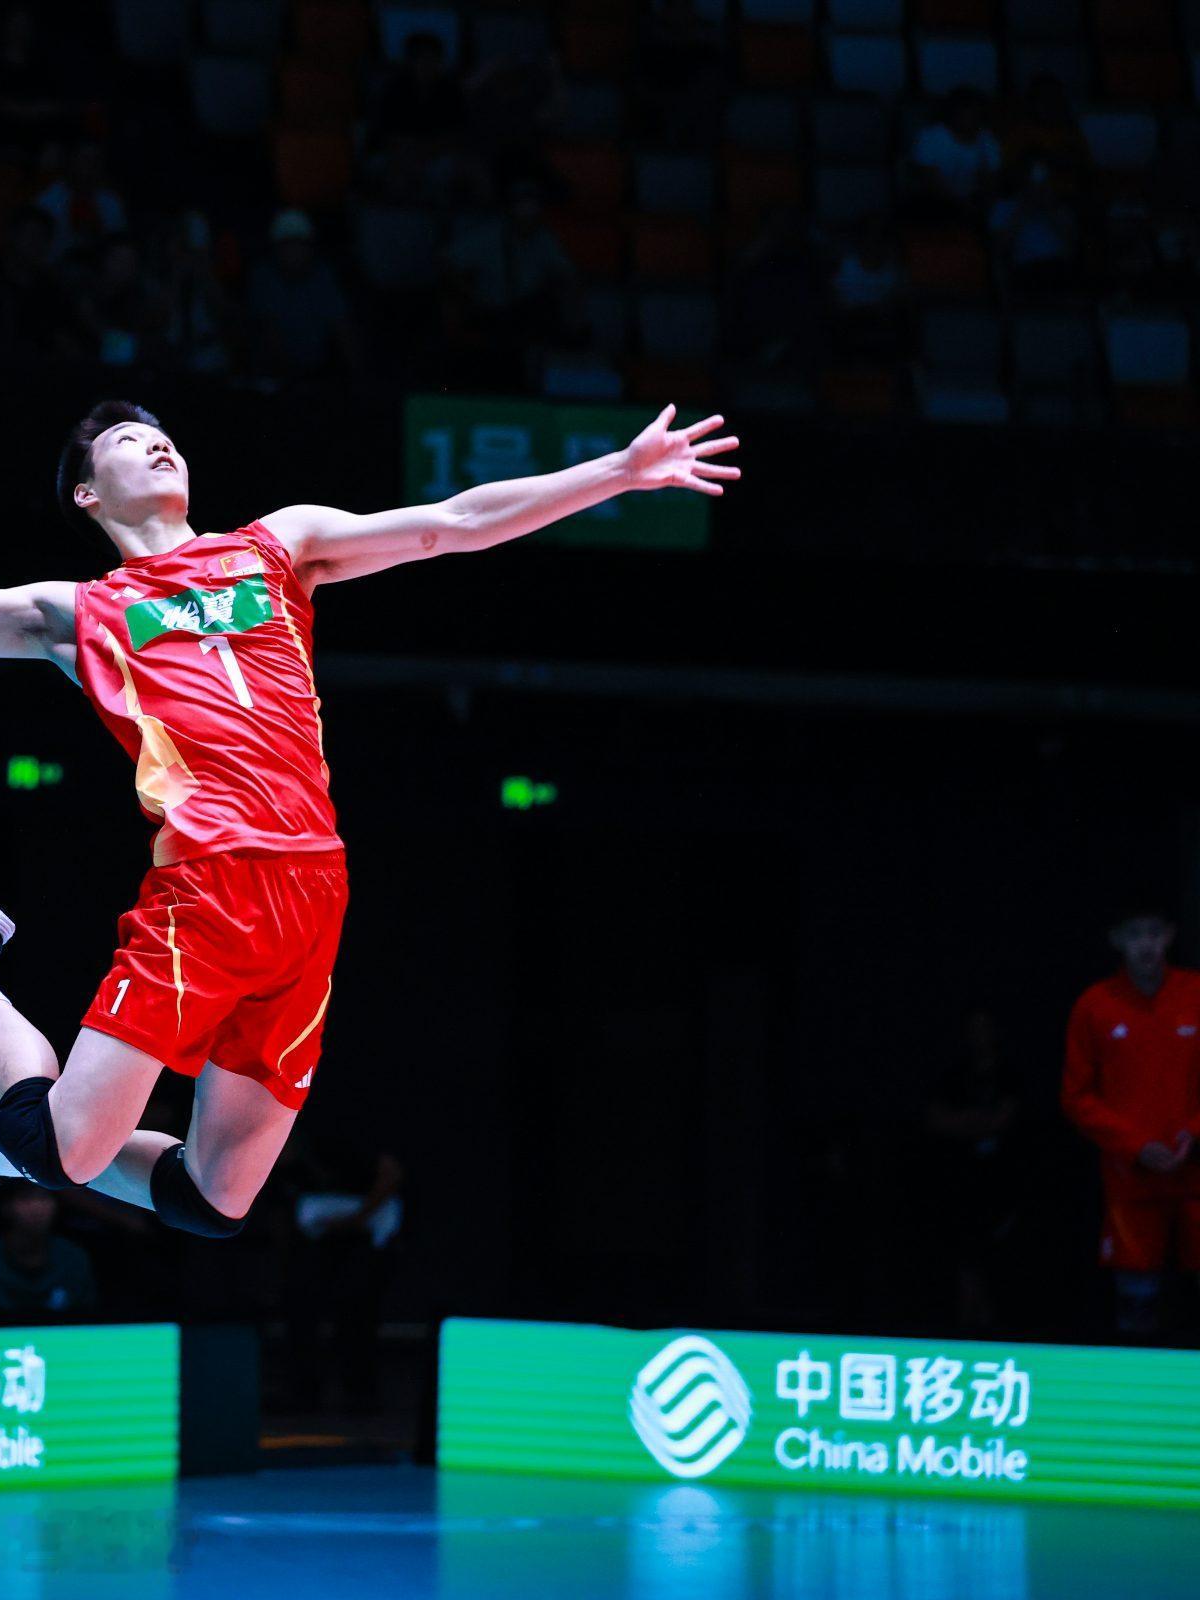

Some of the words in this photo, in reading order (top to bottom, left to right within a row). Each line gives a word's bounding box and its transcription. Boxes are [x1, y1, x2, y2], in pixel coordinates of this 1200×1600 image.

[199, 635, 254, 708] 1
[110, 979, 131, 1015] 1
[776, 1349, 1031, 1427] 中国移动
[775, 1427, 889, 1474] China
[897, 1434, 1029, 1482] Mobile
